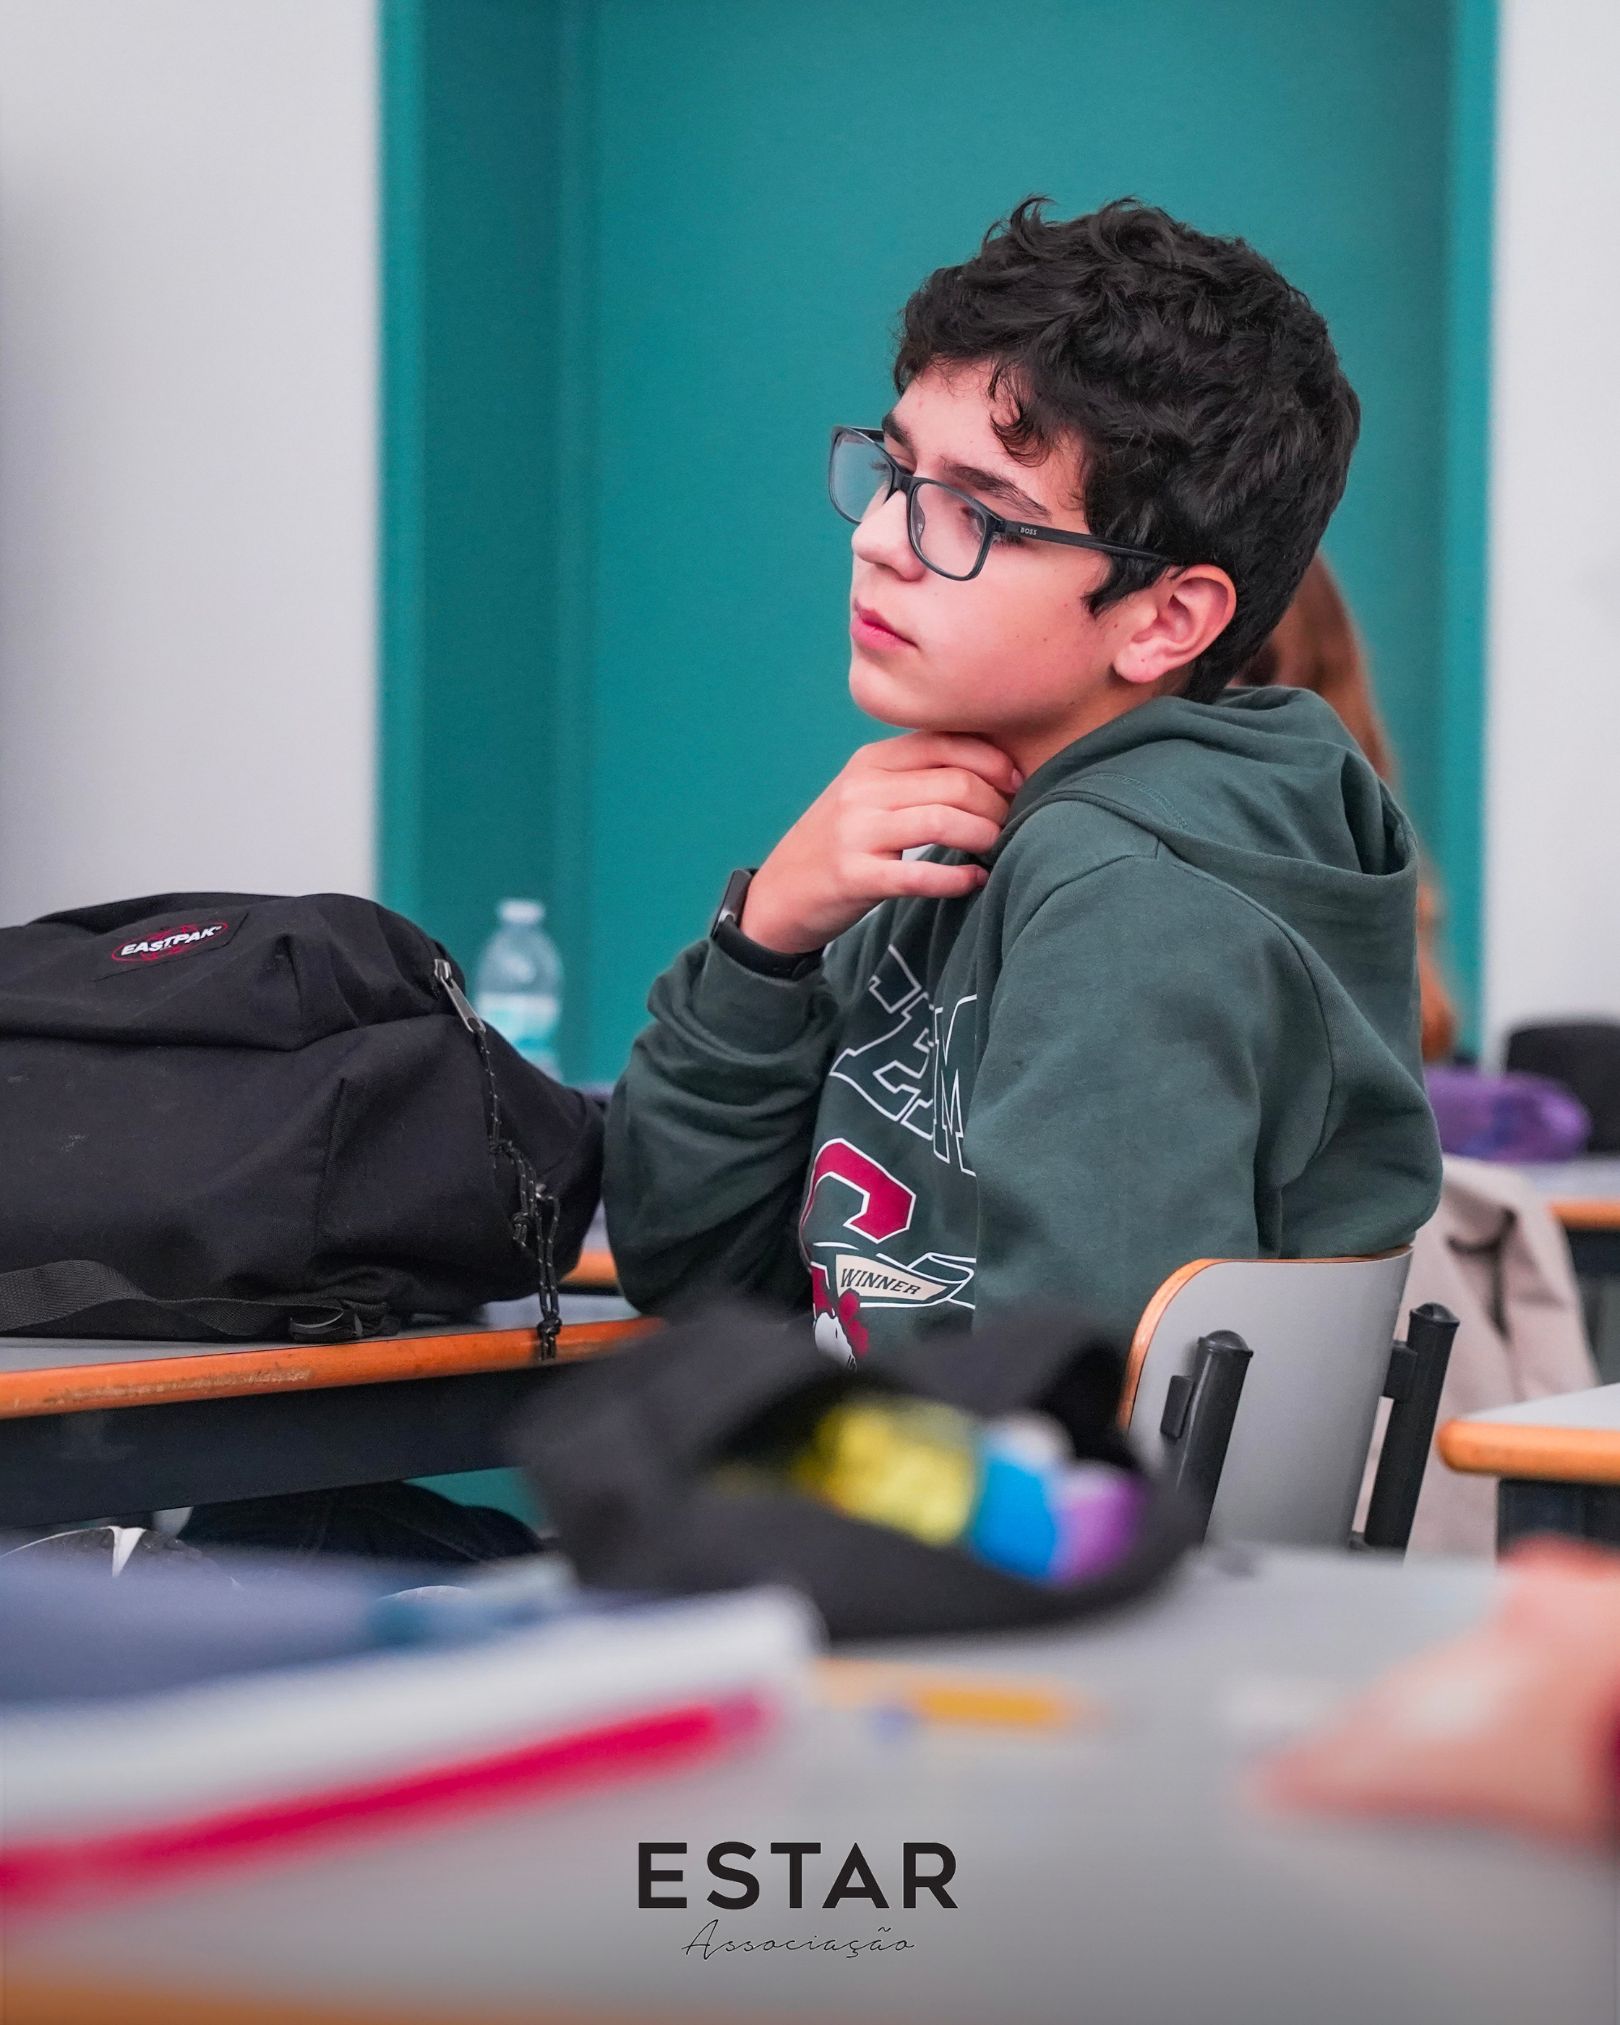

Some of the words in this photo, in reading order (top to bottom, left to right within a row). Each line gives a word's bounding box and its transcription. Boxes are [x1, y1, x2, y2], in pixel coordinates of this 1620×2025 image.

[1020, 526, 1037, 536] BOSS
[120, 926, 219, 956] EASTPAK
[841, 1268, 921, 1295] WINNER
